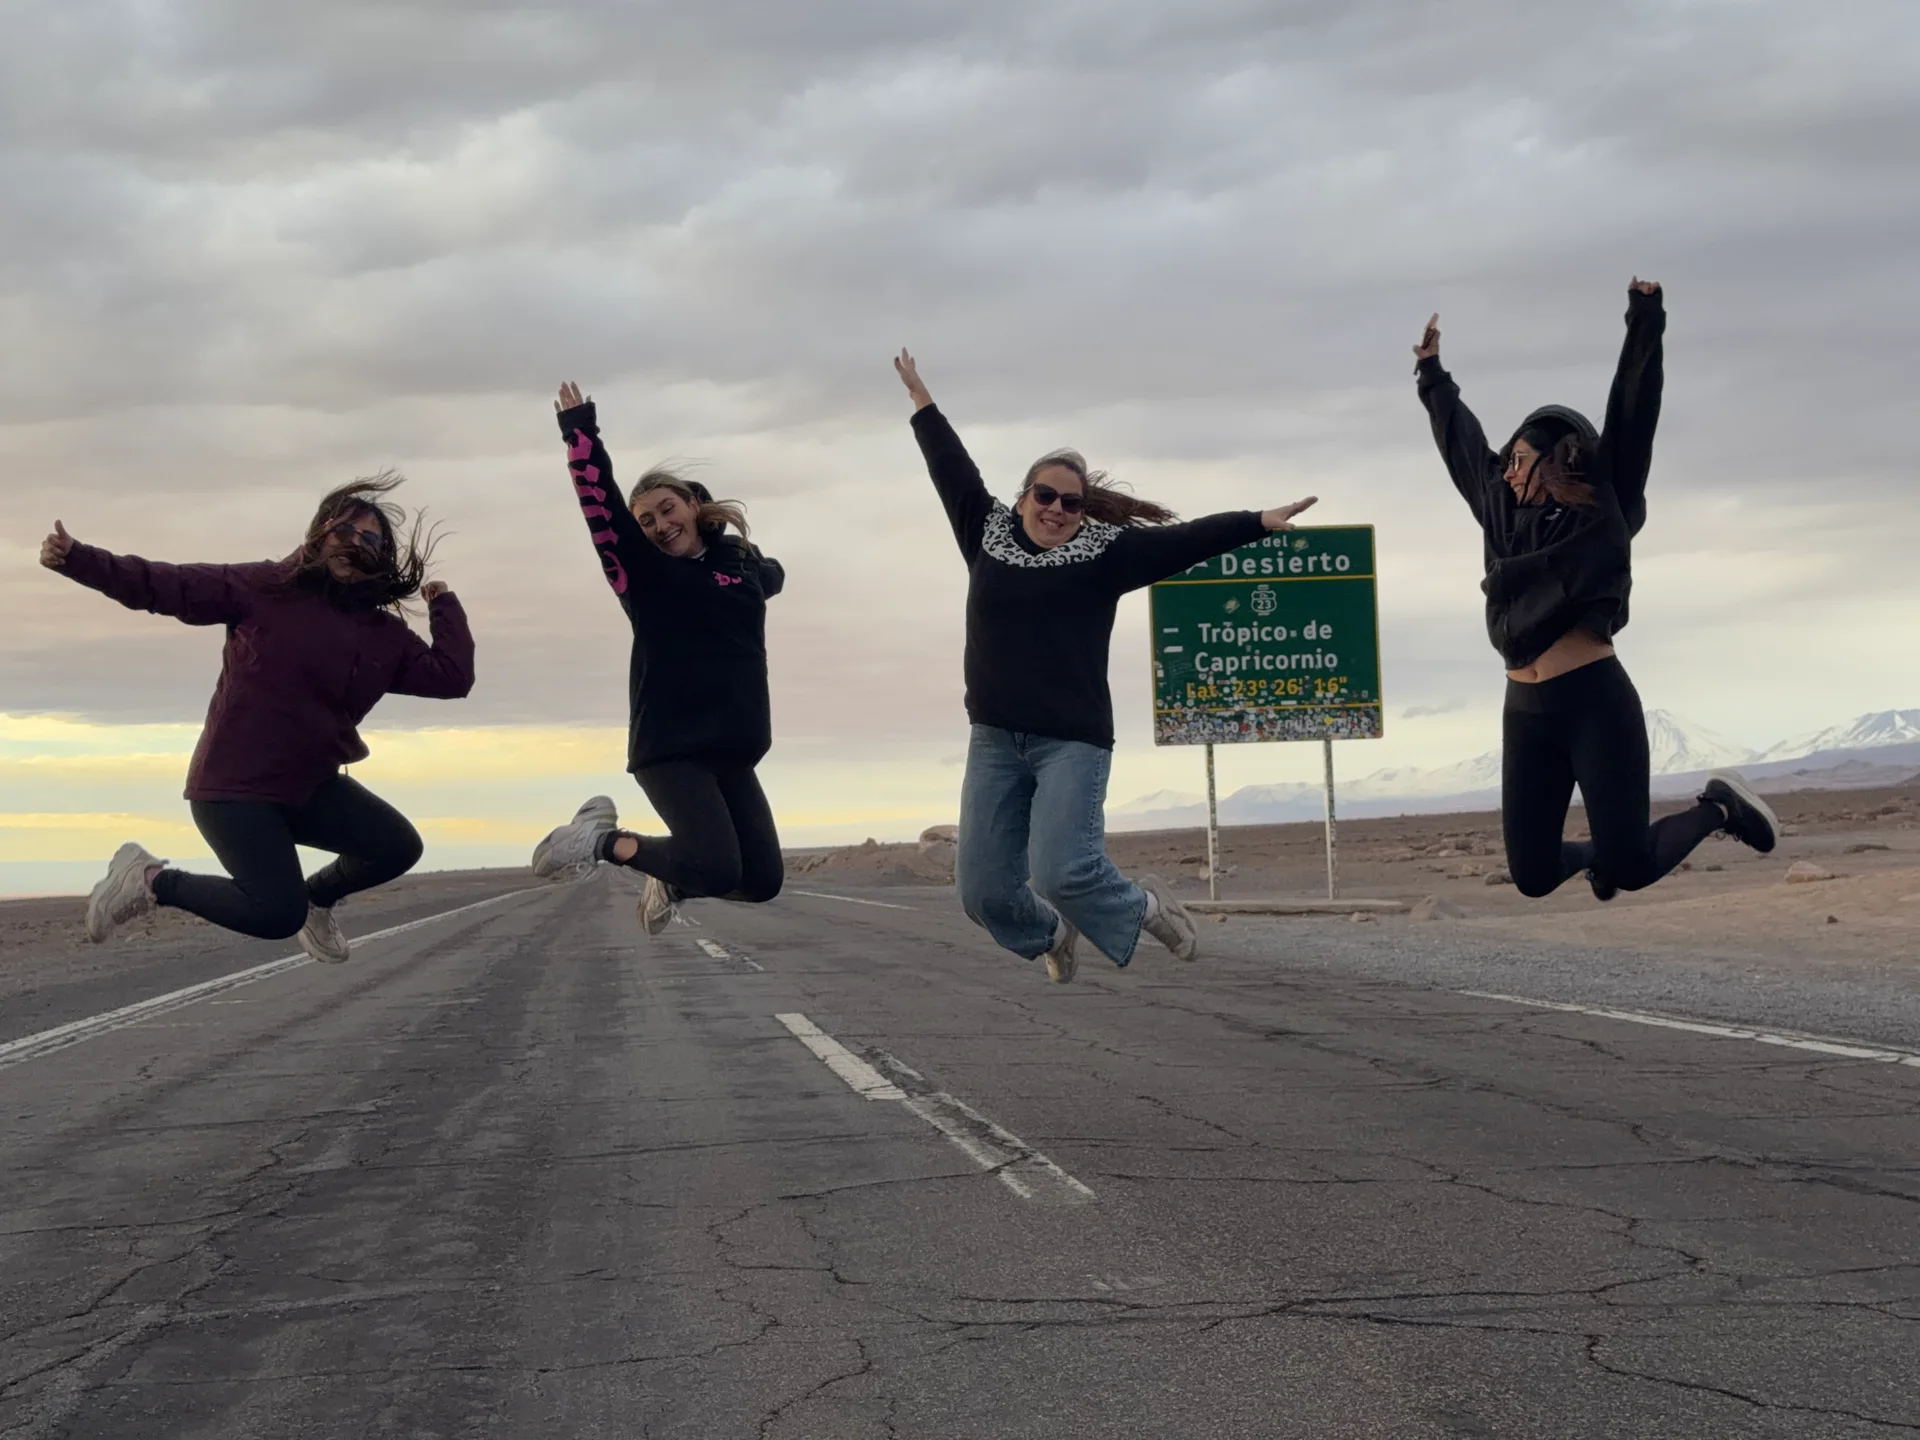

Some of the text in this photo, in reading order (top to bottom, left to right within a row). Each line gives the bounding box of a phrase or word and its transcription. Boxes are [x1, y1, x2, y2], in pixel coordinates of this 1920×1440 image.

[1262, 535, 1288, 548] del
[1221, 551, 1351, 576] Desierto
[1257, 600, 1272, 610] 23
[1303, 620, 1333, 641] de
[1195, 648, 1339, 675] Capricornio
